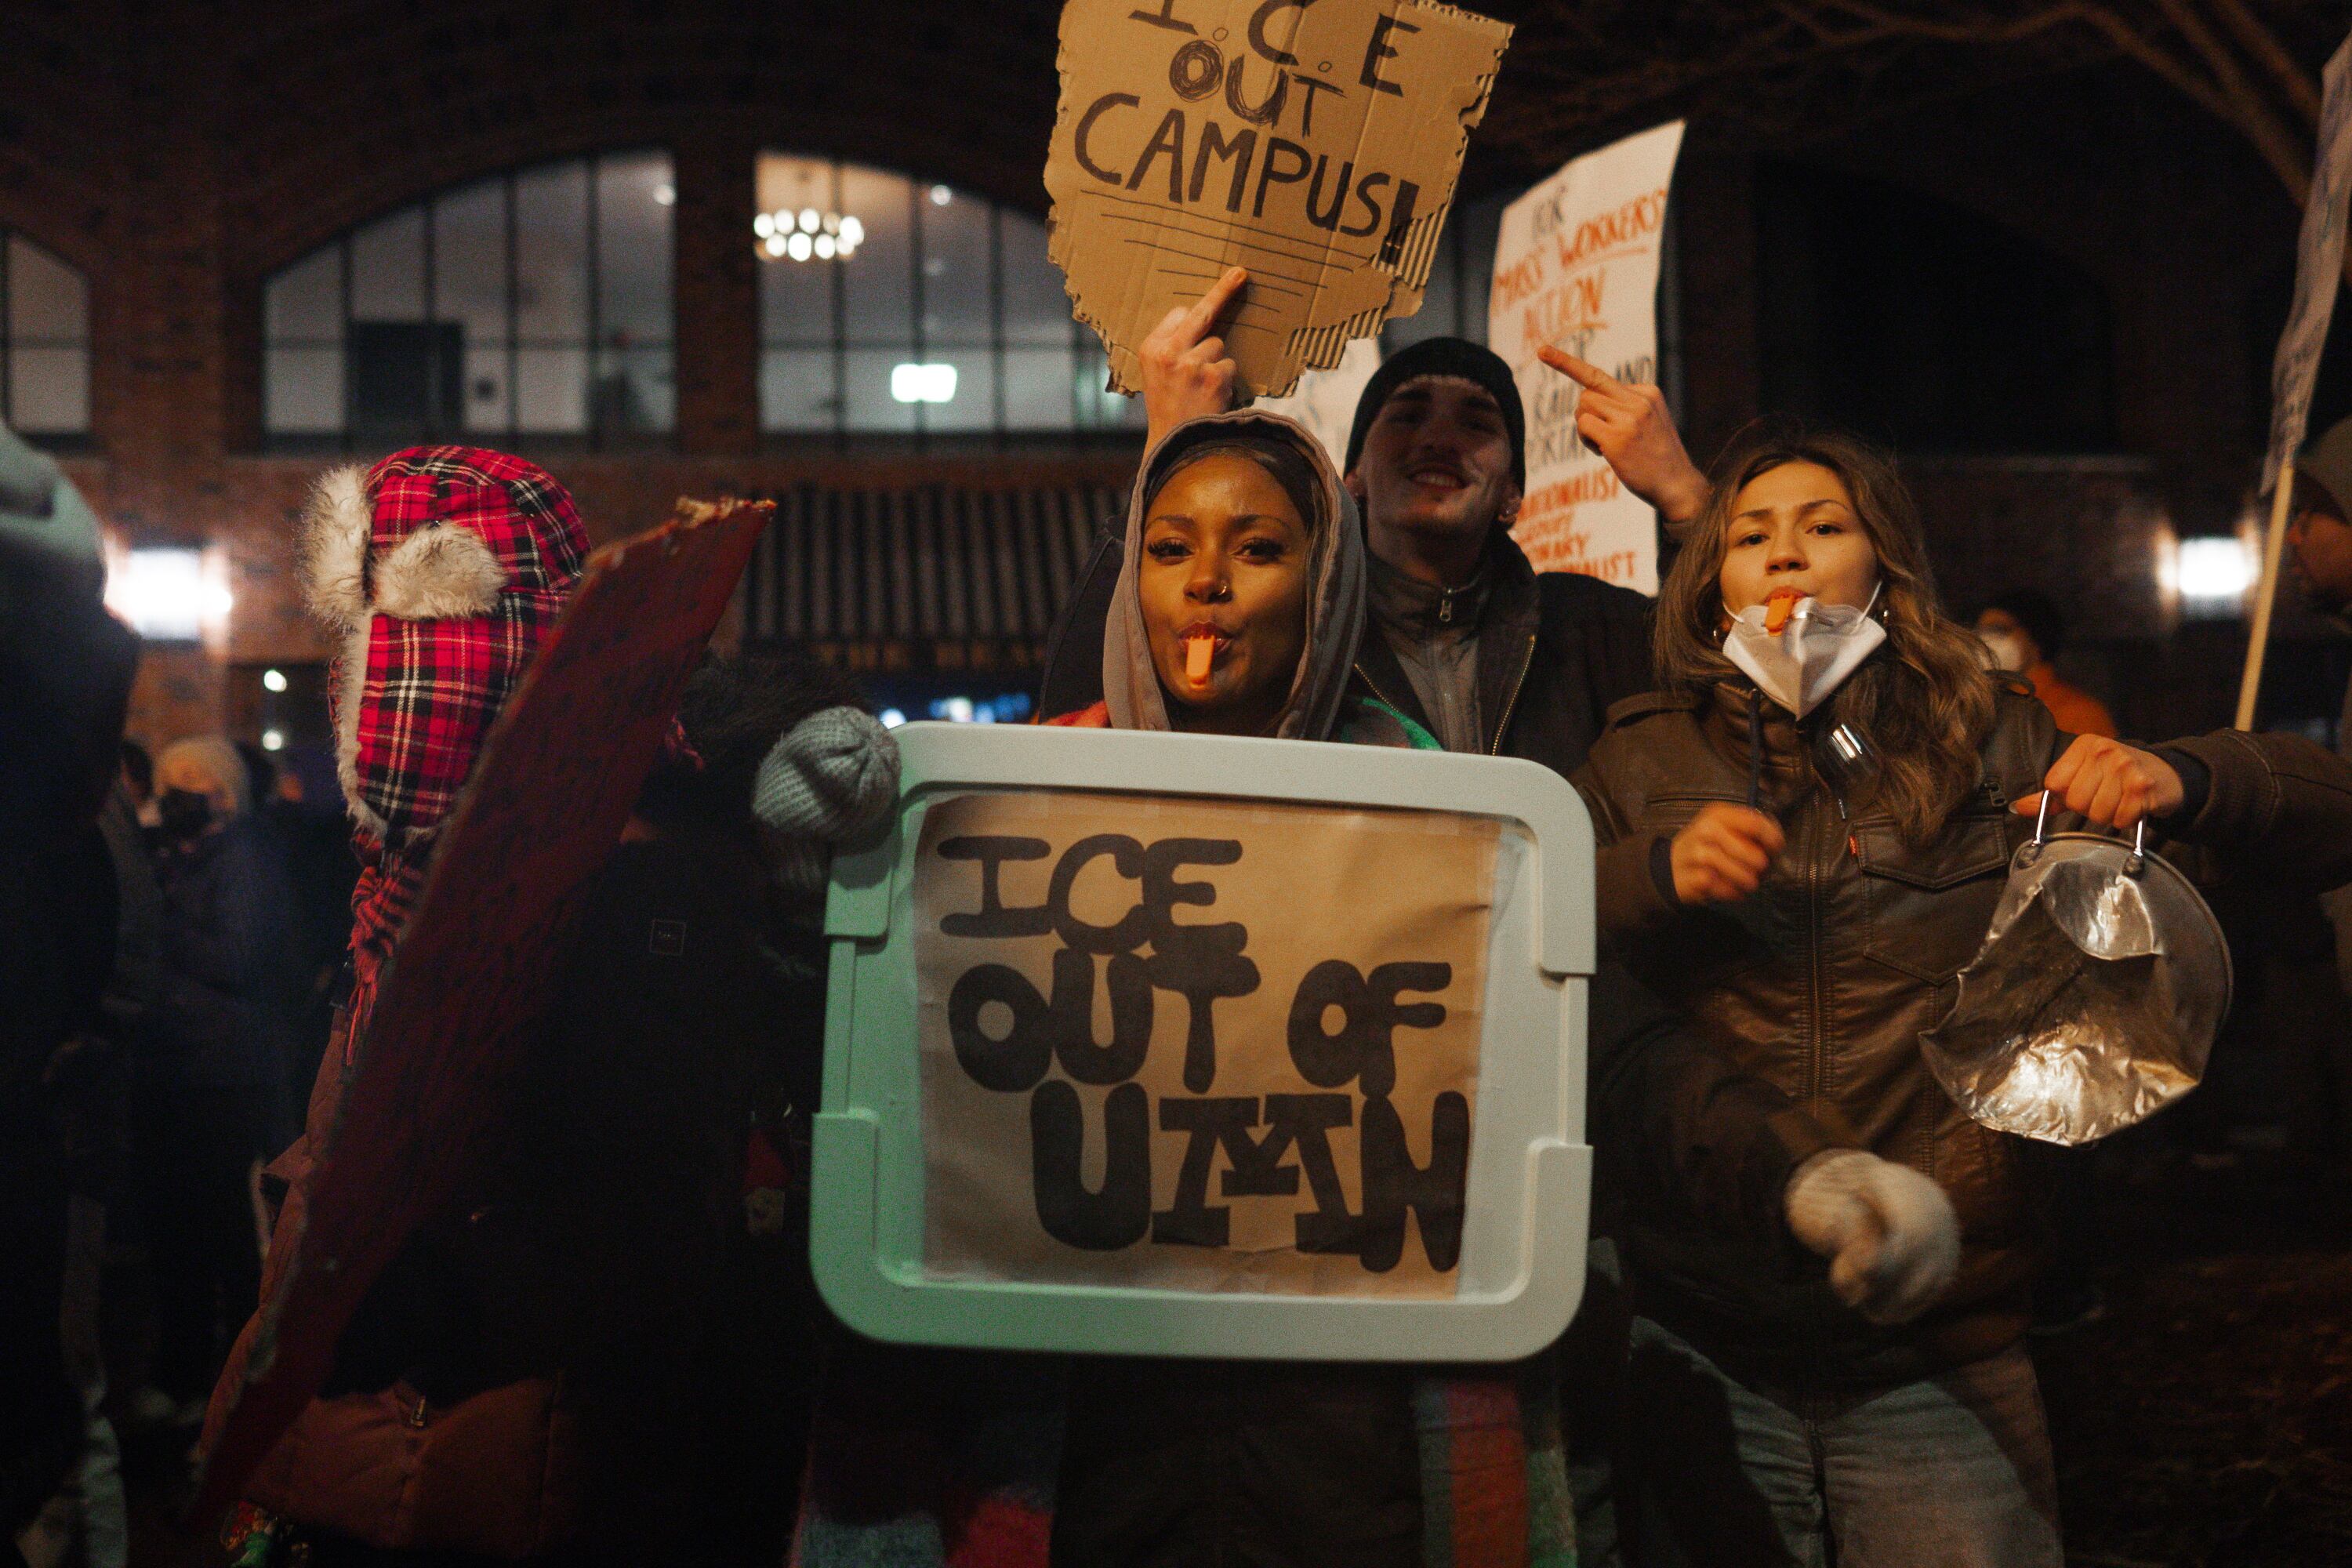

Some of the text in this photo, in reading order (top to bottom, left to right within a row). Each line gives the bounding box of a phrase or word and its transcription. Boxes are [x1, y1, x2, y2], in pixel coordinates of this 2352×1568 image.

[1168, 39, 1348, 139] OUT
[1074, 92, 1421, 266] CAMPUS!
[936, 832, 1248, 954] ICE
[947, 948, 1452, 1095] OUT OF
[1029, 1081, 1470, 1272] UMN
